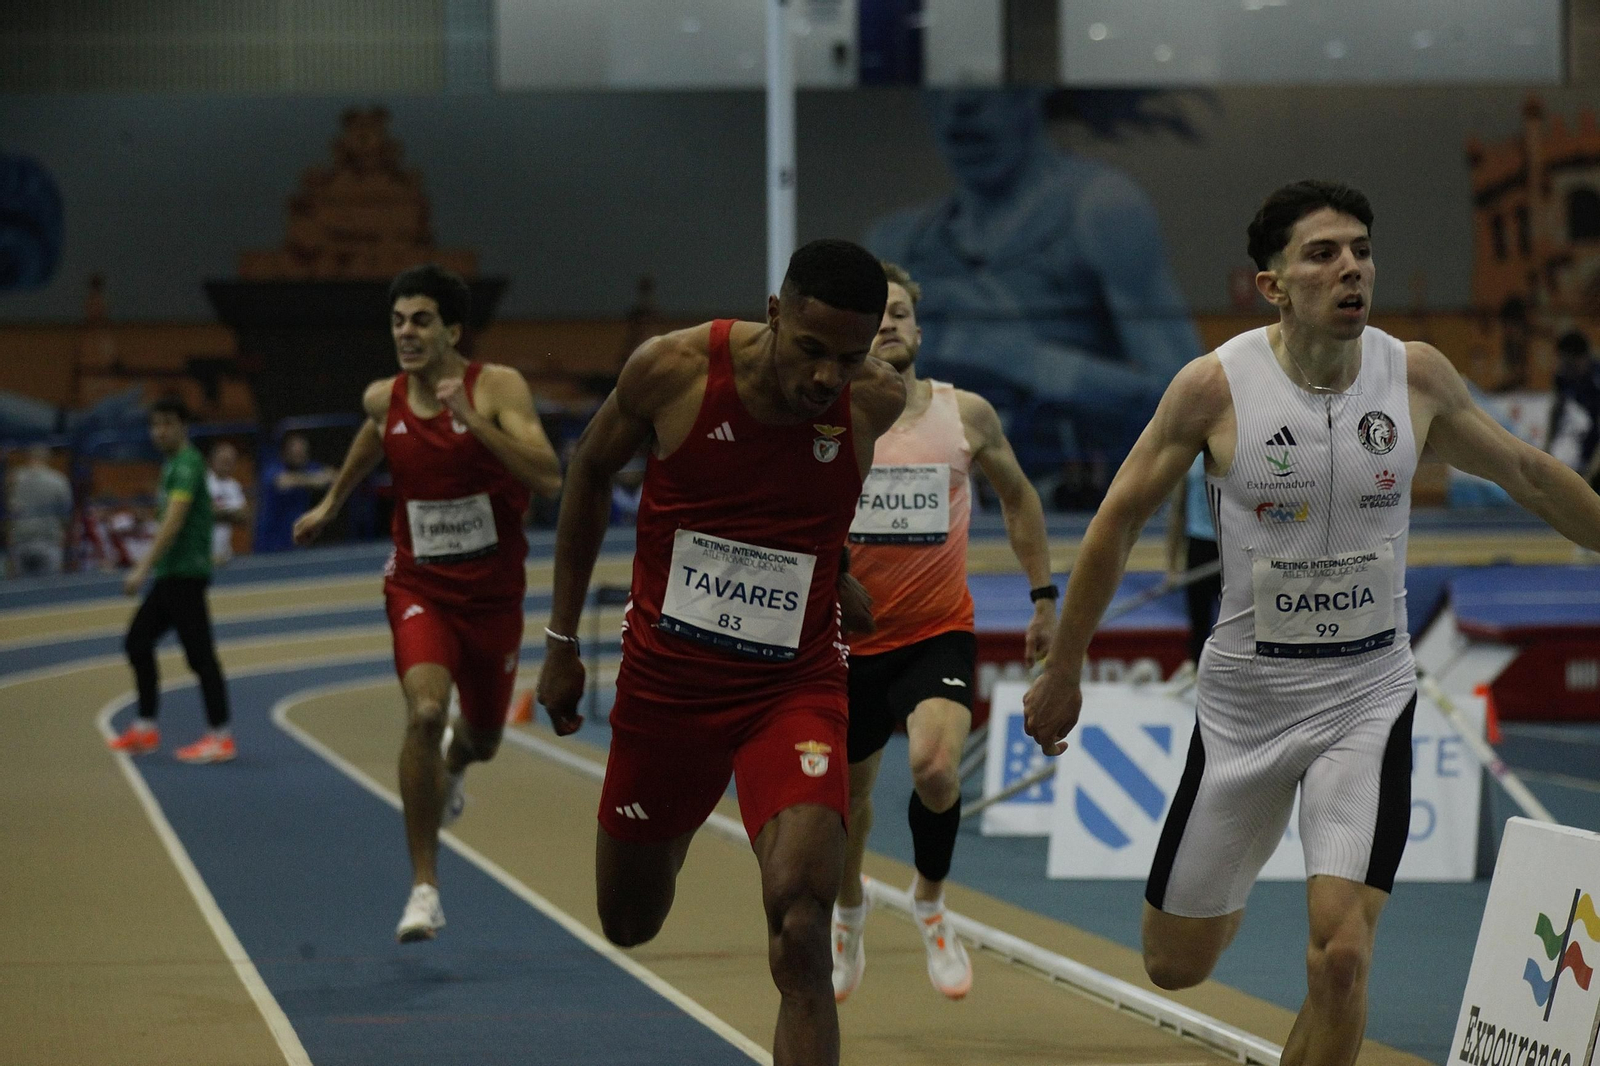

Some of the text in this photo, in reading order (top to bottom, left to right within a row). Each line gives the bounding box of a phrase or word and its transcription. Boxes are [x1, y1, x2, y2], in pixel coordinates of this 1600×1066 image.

[1247, 479, 1316, 490] Extremadura
[858, 493, 939, 510] FAULDS
[891, 517, 909, 530] 65
[692, 536, 798, 566] MEETING INTERNACIONAL
[1270, 552, 1379, 571] MEETING INTERNACIONAL
[682, 565, 799, 612] TAVARES
[1276, 584, 1375, 613] GARCÍA
[717, 613, 743, 632] 83
[1315, 623, 1340, 638] 99
